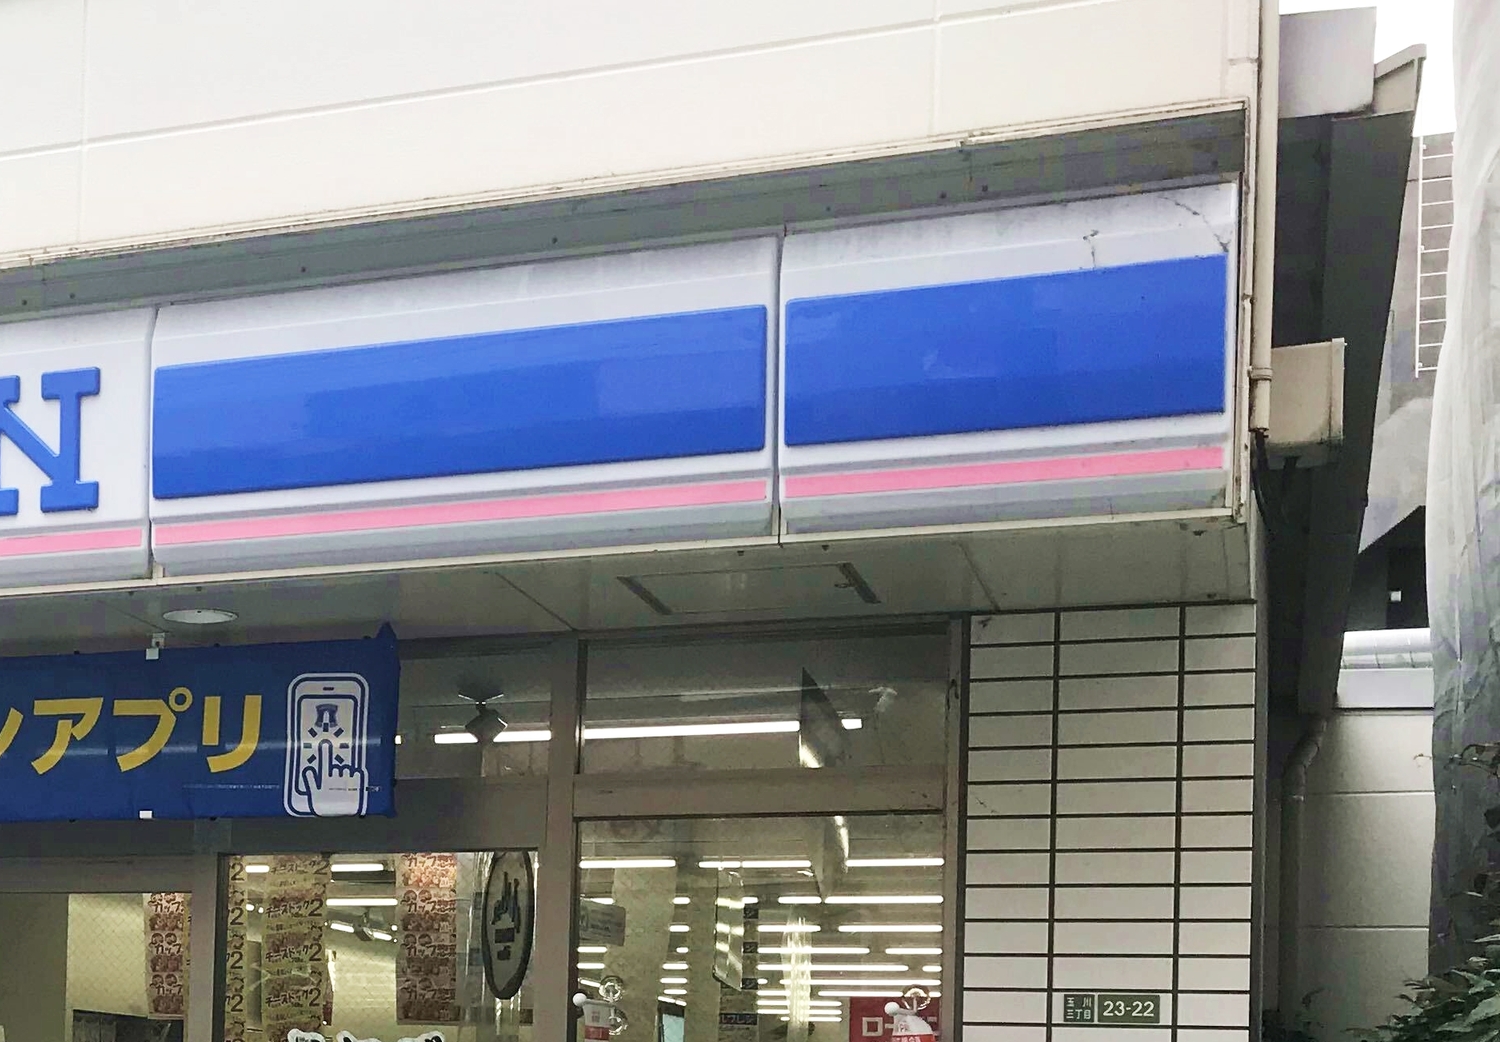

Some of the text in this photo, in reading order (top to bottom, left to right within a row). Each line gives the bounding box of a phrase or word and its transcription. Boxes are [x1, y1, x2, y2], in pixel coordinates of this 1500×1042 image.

[1066, 997, 1092, 1007] 玉川
[1102, 1000, 1155, 1017] 23-22
[1066, 1009, 1091, 1020] 三丁目
